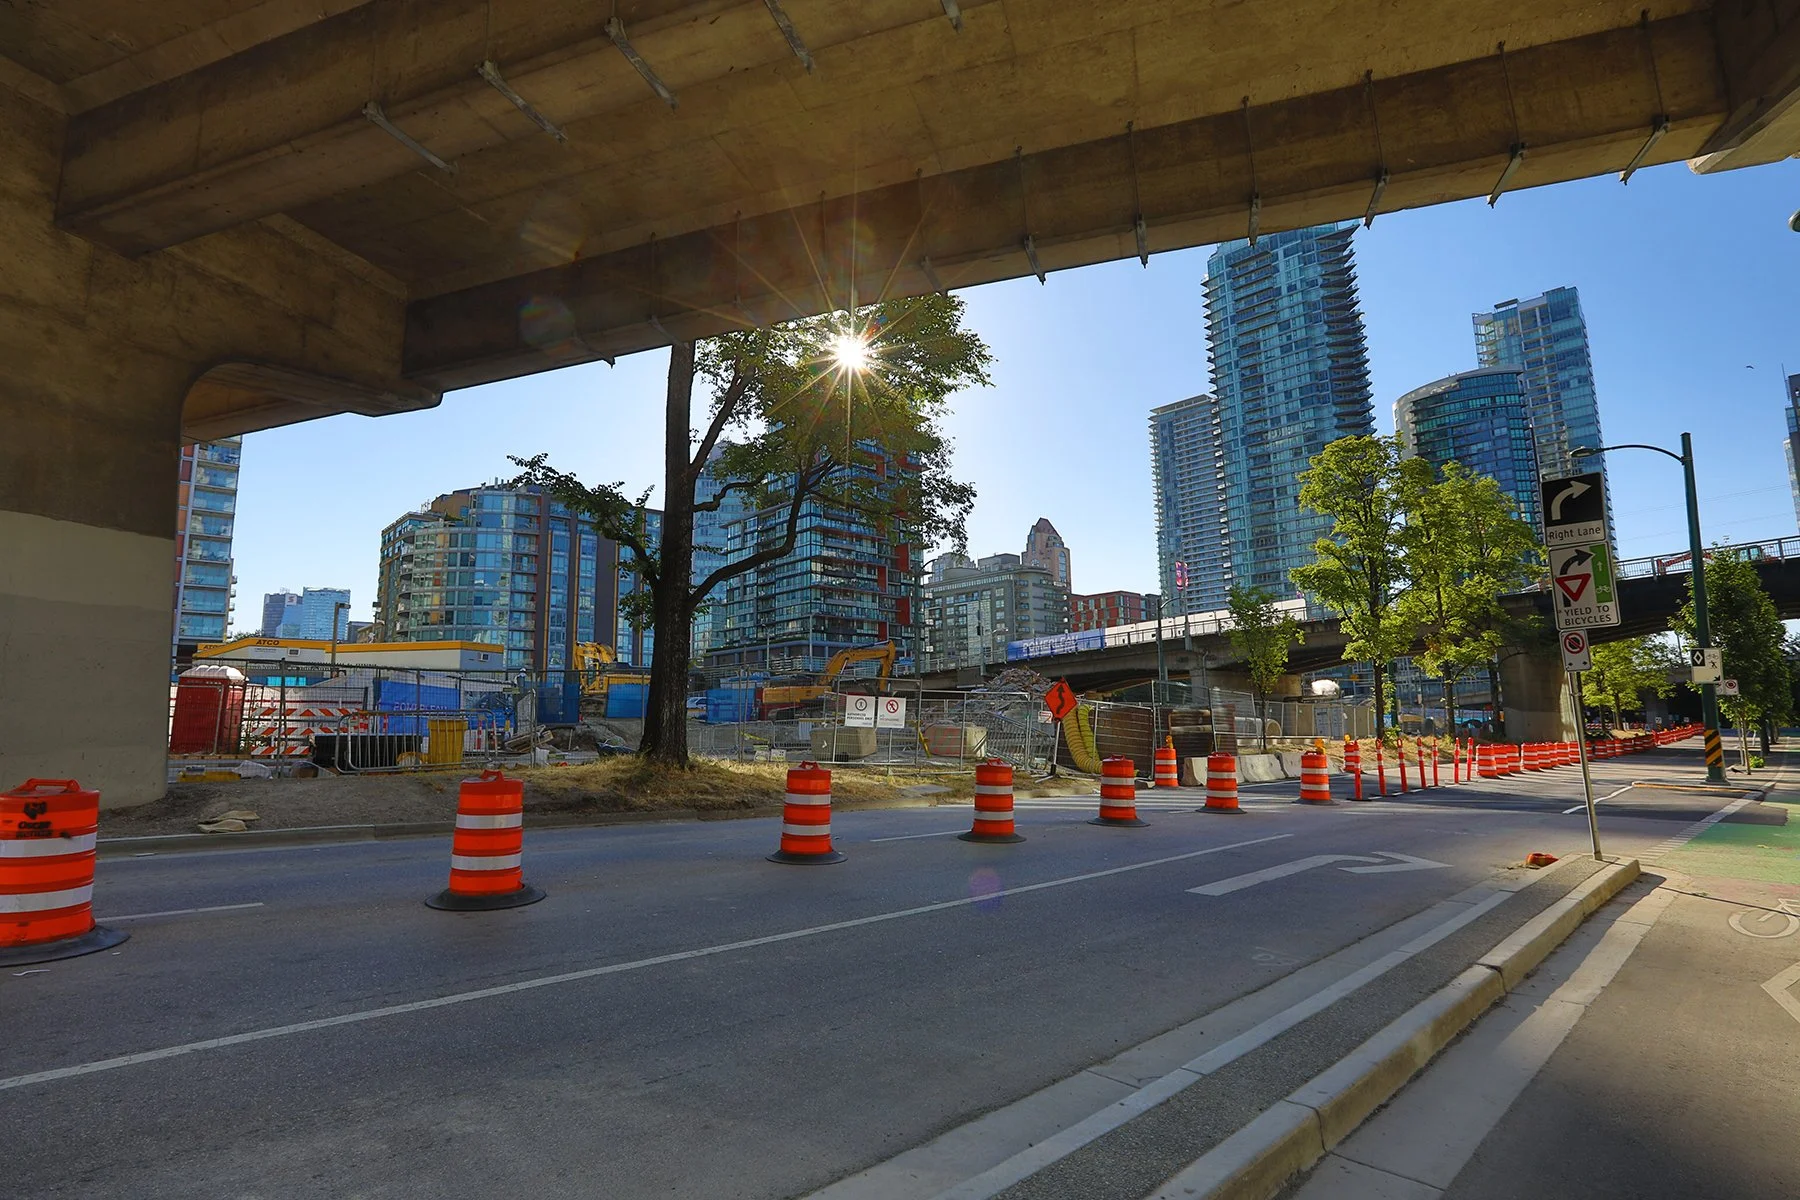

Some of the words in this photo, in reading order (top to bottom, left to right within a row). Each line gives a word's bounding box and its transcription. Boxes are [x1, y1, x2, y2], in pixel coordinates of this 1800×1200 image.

[1549, 530, 1574, 540] Right
[1577, 526, 1601, 537] Lane
[1564, 607, 1592, 616] YIELD
[1596, 605, 1610, 613] TO
[1564, 614, 1612, 626] BICYCLES
